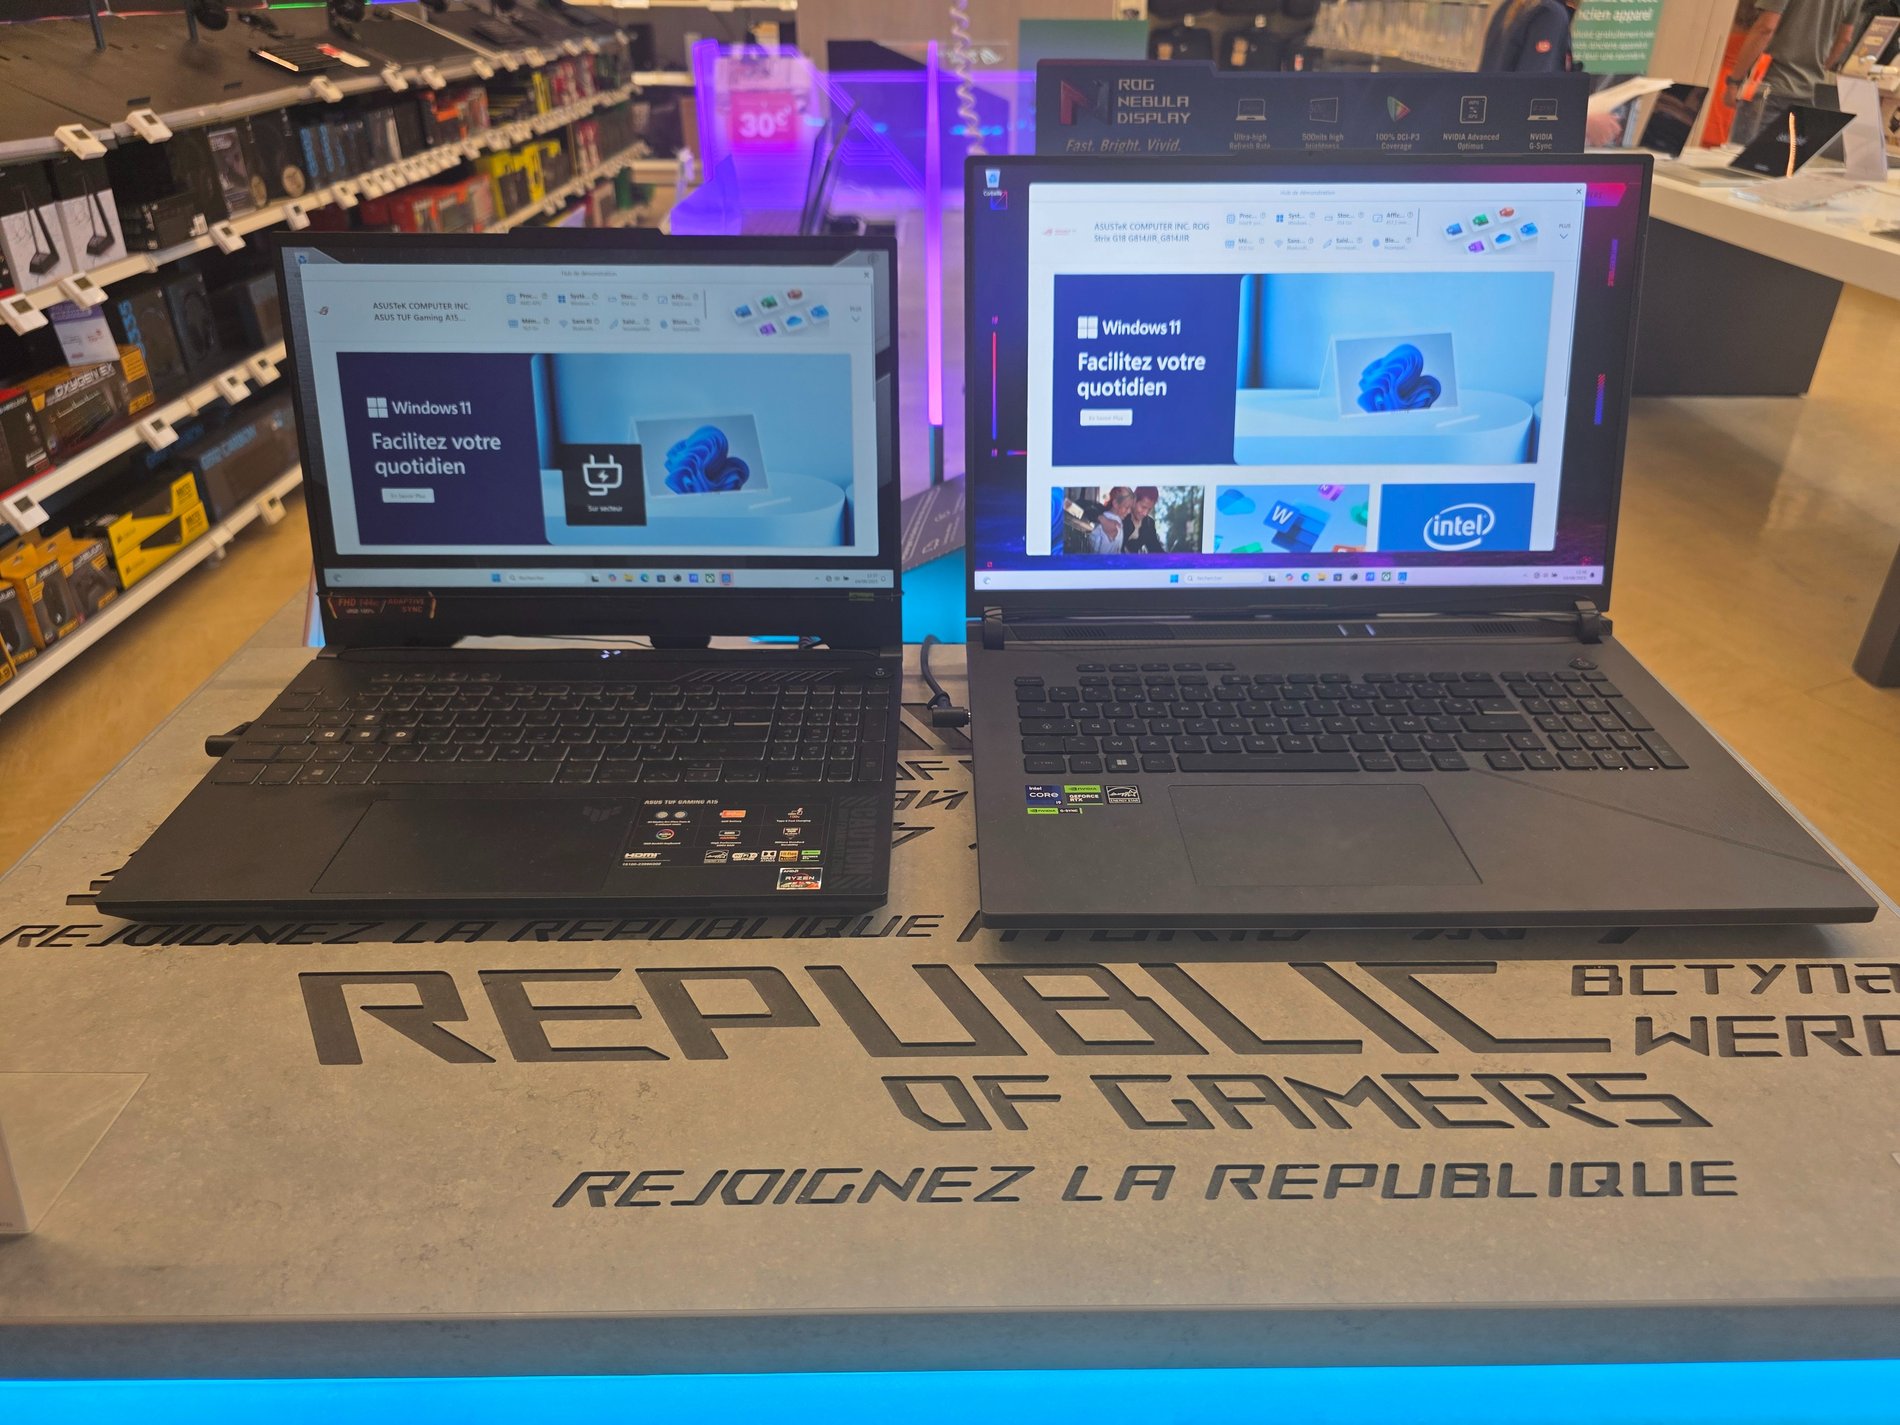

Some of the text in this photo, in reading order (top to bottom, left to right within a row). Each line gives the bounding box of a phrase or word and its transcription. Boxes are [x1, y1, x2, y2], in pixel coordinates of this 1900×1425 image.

[1118, 79, 1155, 91] ROG
[1117, 96, 1190, 108] NEBULA
[1117, 113, 1192, 124] DISPLAY
[1233, 133, 1267, 142] Ultra-high
[1302, 133, 1344, 142] 500nits high
[1376, 133, 1420, 141] 100% DCI-P3
[1443, 133, 1500, 141] NVIDIA Advanced
[1530, 133, 1553, 141] NVIDIA
[1066, 139, 1181, 153] Fast. Bright. Vivid.
[1229, 142, 1255, 150] Refresh
[1381, 142, 1412, 151] Coverage
[1457, 142, 1484, 151] Optimus
[1529, 142, 1553, 151] G-Sync
[1094, 222, 1210, 231] ASUSTeK COMPUTER INC. ROG
[373, 302, 471, 310] ASUSTeK COMPUTER INC.
[374, 313, 395, 321] ASUS
[397, 313, 411, 321] TUF
[414, 313, 443, 323] Gaming
[1102, 319, 1182, 336] Windows 11
[1078, 351, 1206, 371] Facilitez votre
[1077, 376, 1168, 401] quotidien
[392, 401, 473, 415] Windows 11
[371, 432, 502, 451] Facilitez votre
[375, 457, 466, 478] quotidien
[587, 504, 599, 513] Sur
[1433, 513, 1484, 537] intel
[0, 922, 384, 948] REJOIGNEZ
[392, 920, 498, 945] LA
[507, 914, 945, 943] REPUBLIQUE
[298, 962, 1610, 1065] REPUBLIC
[881, 1073, 1713, 1131] OF GAMERS
[552, 1160, 1739, 1208] REJOIGNEZ LA REPUBLIQUE
